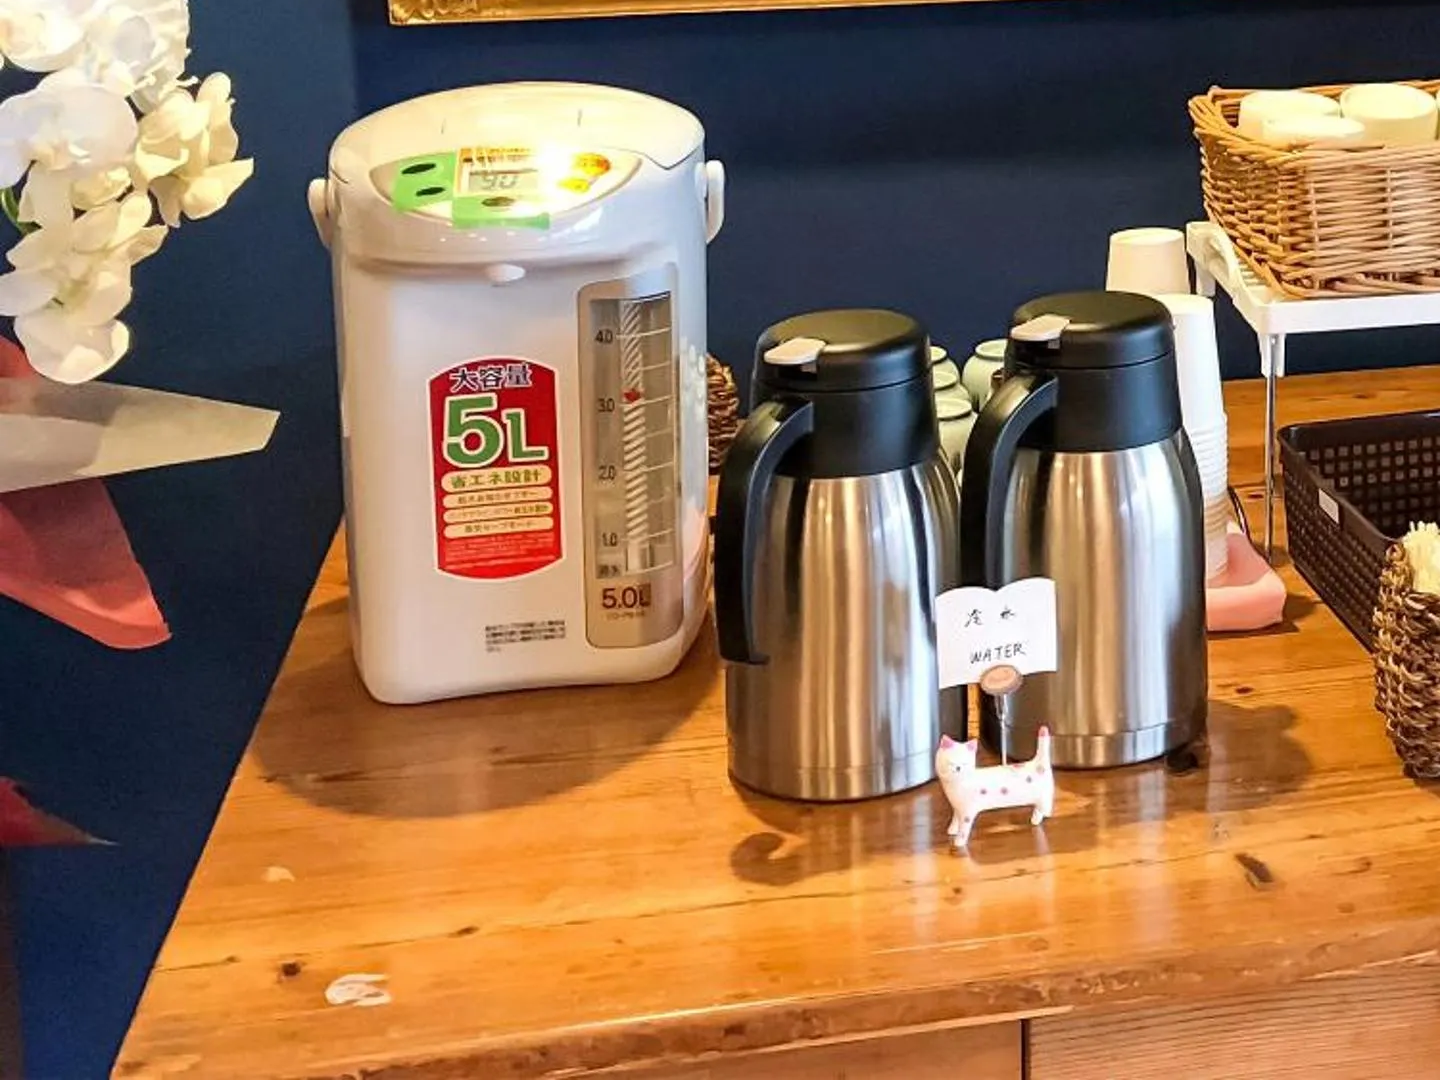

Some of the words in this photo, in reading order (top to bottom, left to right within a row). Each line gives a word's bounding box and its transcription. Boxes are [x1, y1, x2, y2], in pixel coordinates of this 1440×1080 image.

[449, 363, 532, 393] 大容量
[443, 392, 549, 468] 5L
[450, 469, 541, 489] 省エネ設計
[602, 584, 651, 609] 5.0L
[970, 641, 1026, 664] WATER
